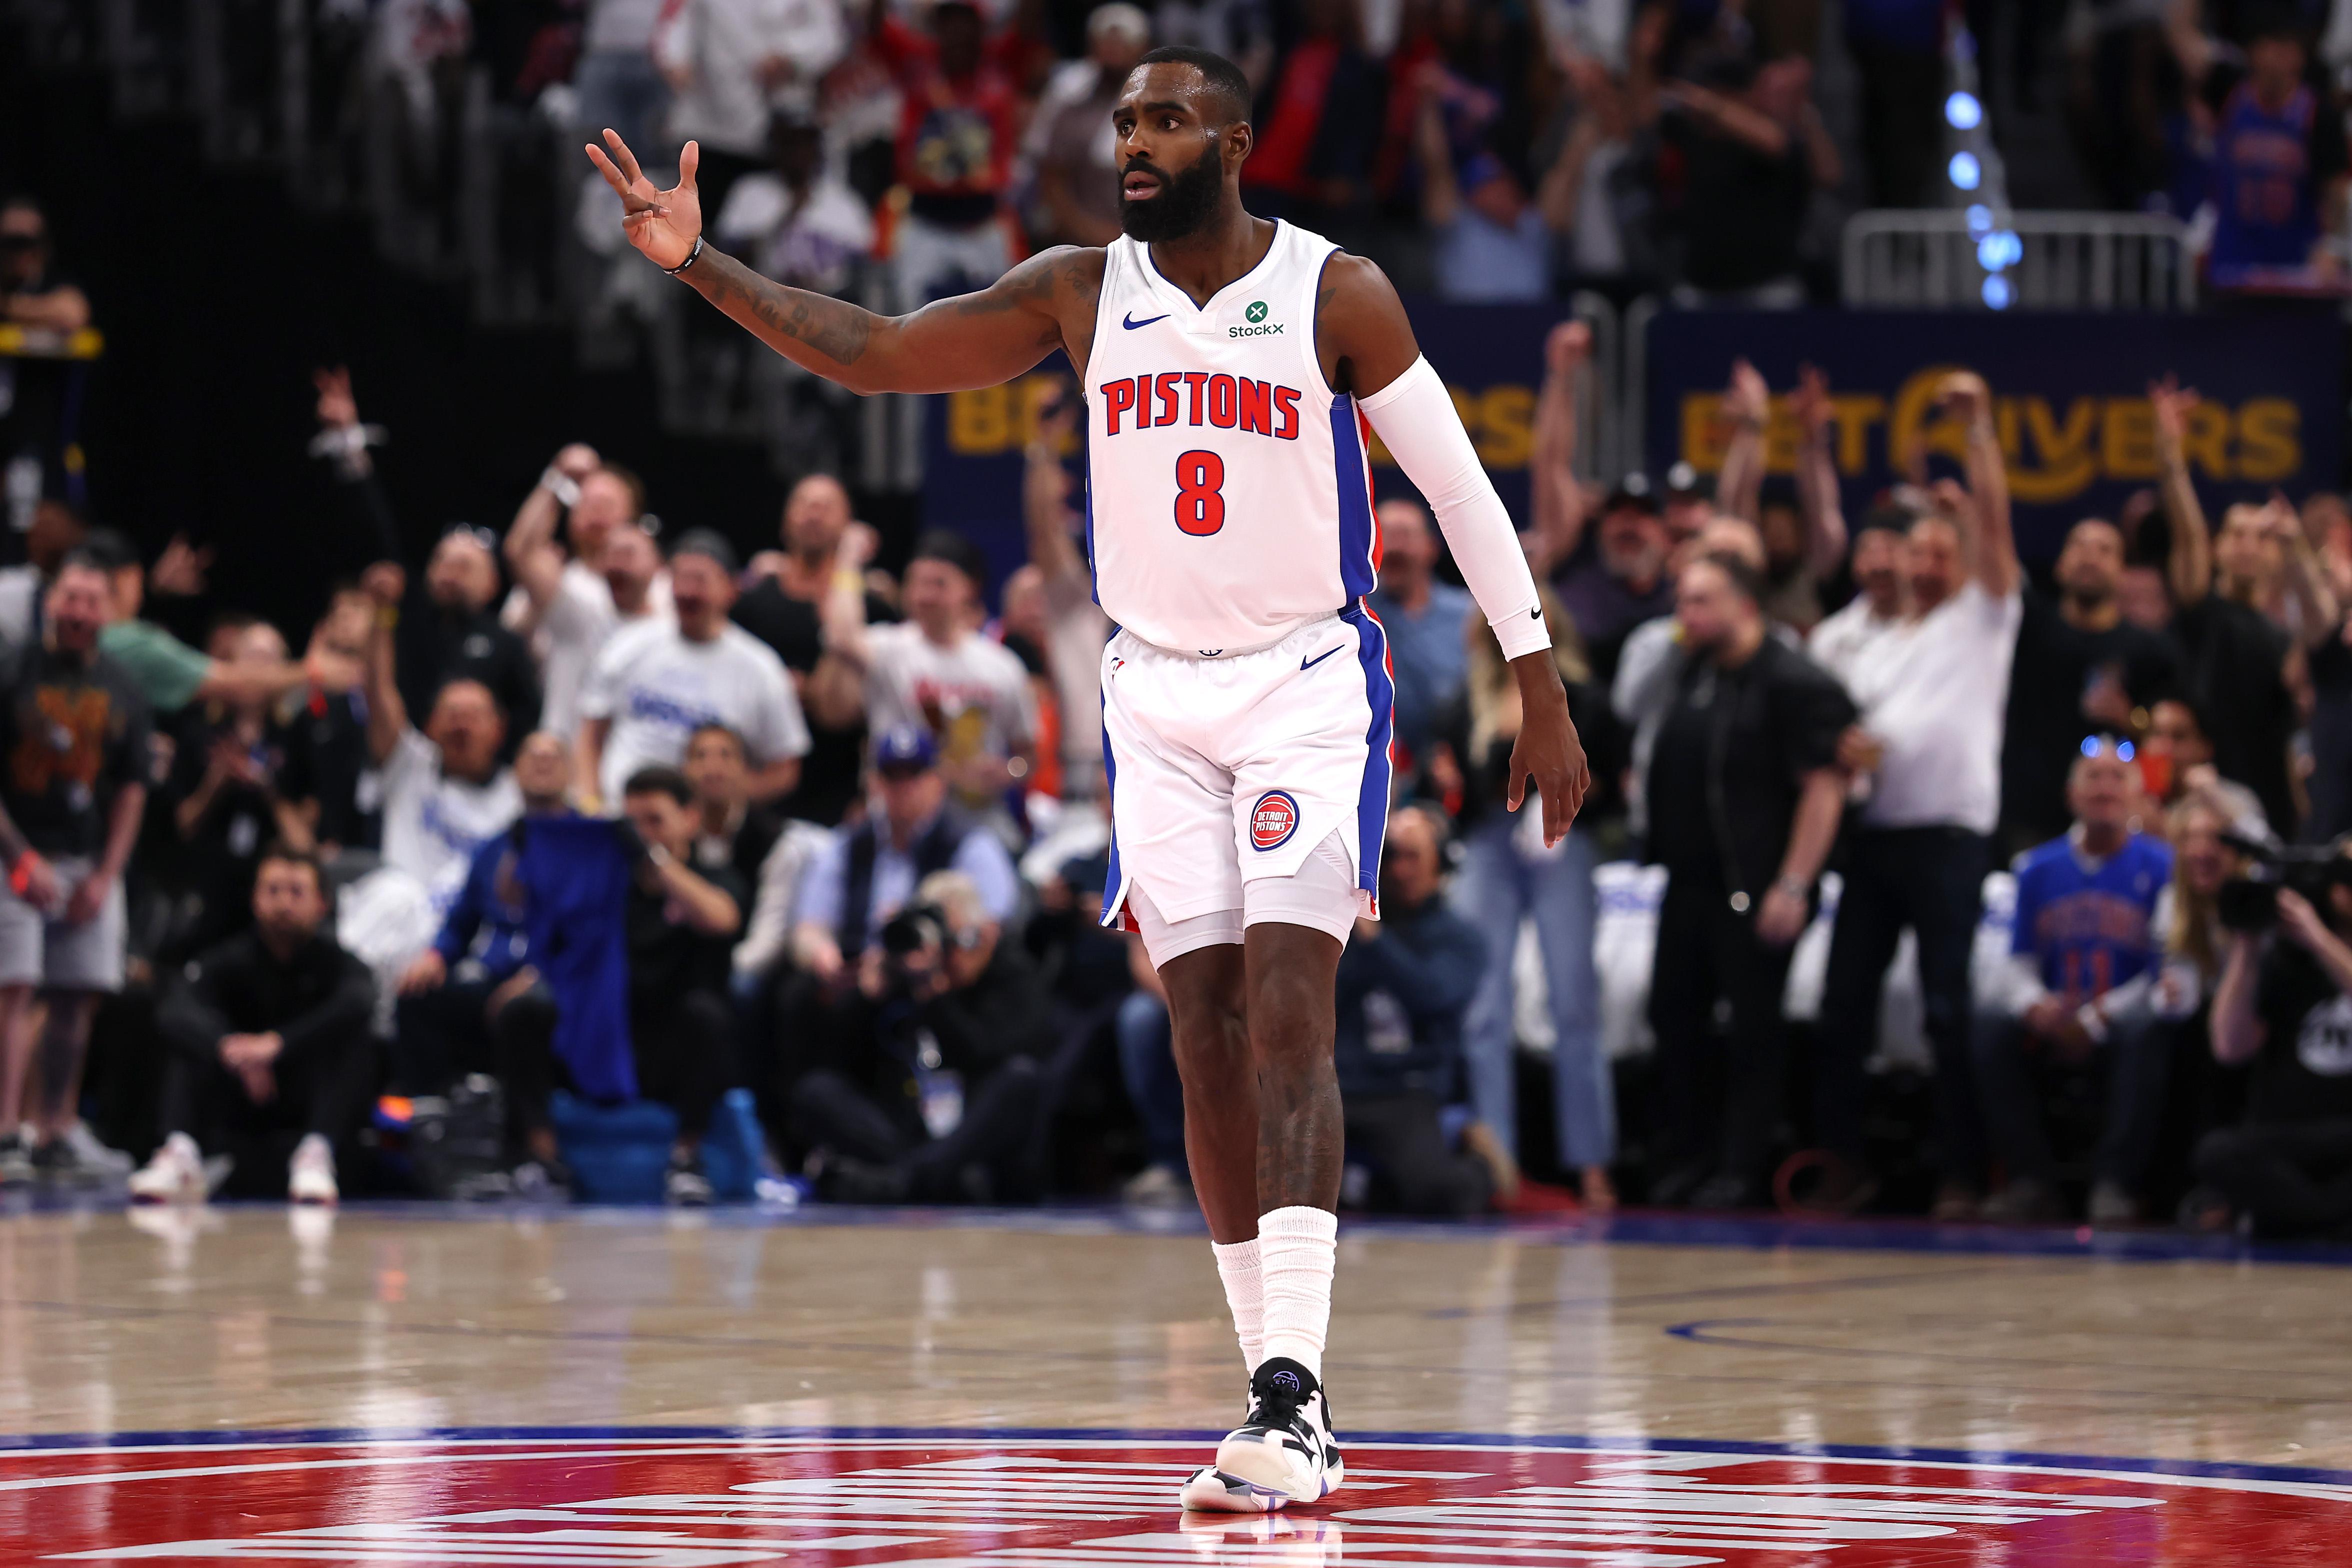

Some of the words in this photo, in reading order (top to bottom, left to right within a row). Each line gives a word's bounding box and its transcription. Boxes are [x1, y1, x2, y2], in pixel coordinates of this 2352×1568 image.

[1228, 323, 1284, 338] StockX
[1100, 372, 1302, 441] PISTONS
[1174, 450, 1225, 537] 8
[1258, 812, 1288, 821] DETROIT
[1256, 822, 1286, 832] PISTONS
